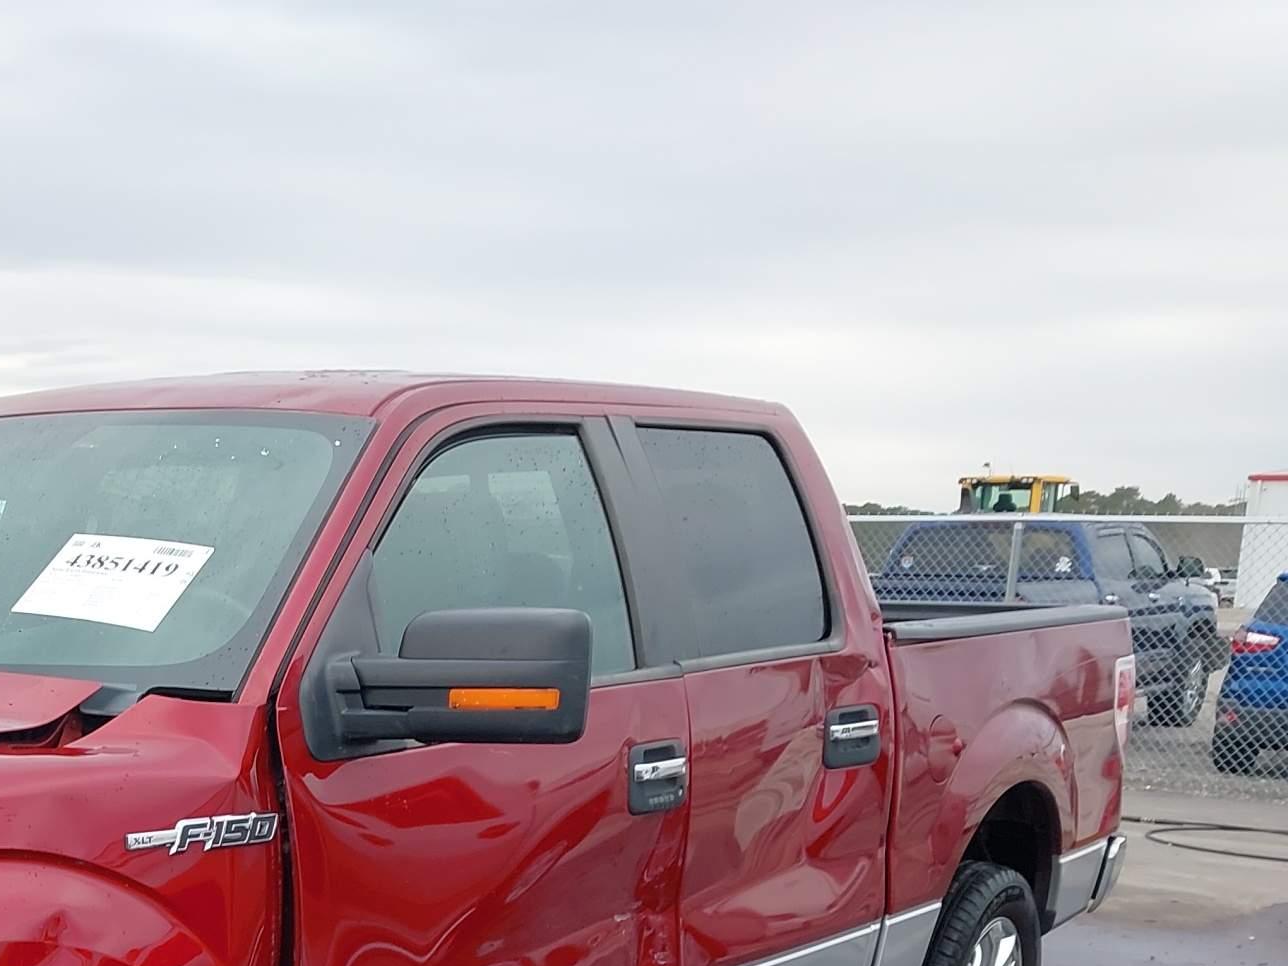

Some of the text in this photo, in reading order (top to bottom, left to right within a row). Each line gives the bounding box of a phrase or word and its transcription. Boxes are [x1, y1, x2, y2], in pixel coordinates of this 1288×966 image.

[65, 553, 180, 577] 43851419
[133, 812, 278, 855] XLT F-150
